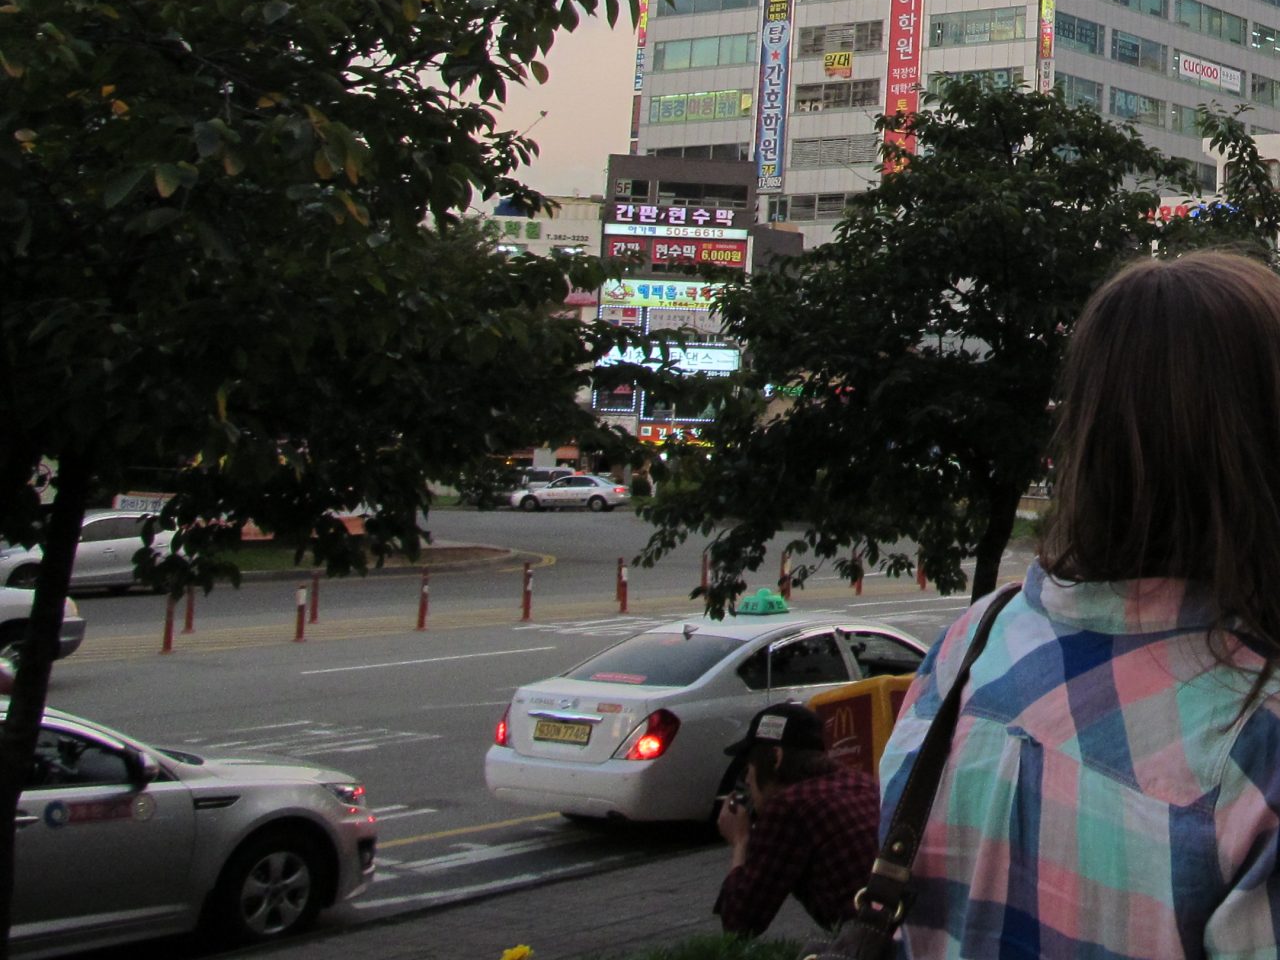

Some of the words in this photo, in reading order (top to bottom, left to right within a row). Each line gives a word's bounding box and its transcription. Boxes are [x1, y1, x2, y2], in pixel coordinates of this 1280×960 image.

[769, 24, 786, 44] 탑
[825, 53, 850, 67] 임대
[1183, 58, 1219, 80] CUCKOO
[760, 64, 786, 162] 간호학원
[666, 227, 725, 238] 505-6613
[656, 243, 697, 259] 현수막
